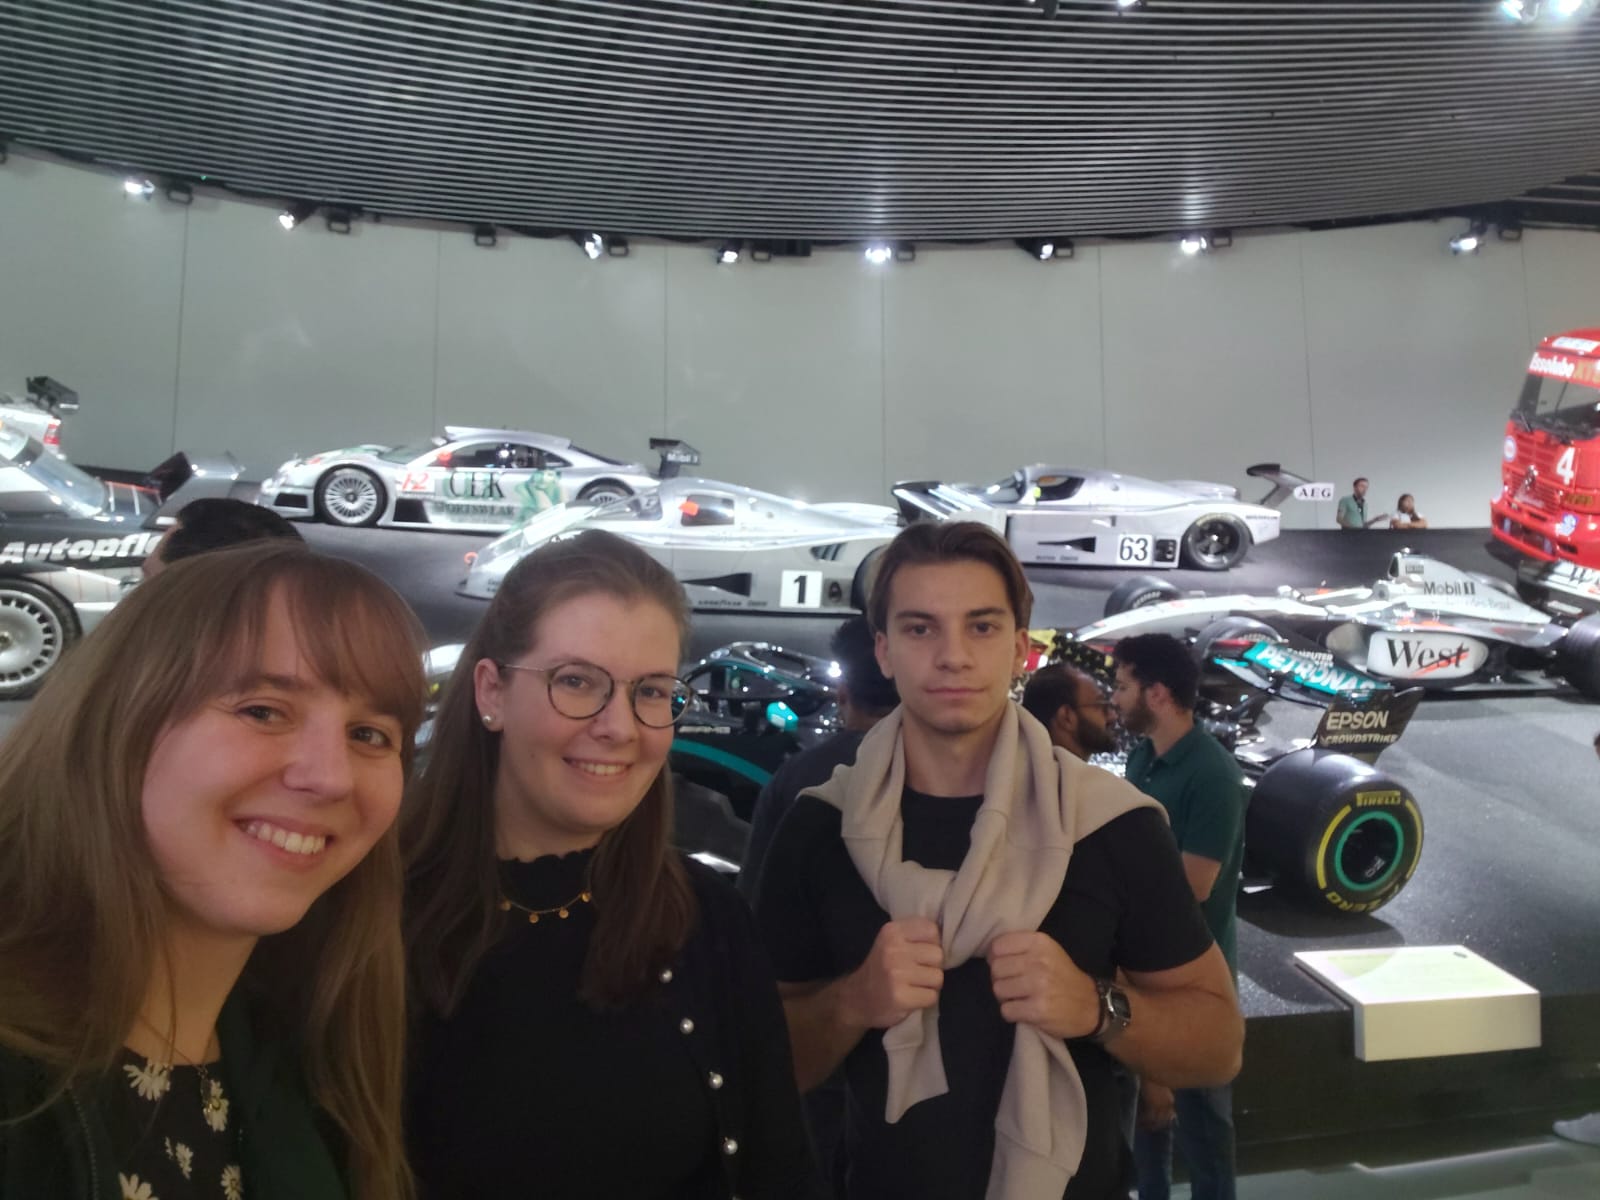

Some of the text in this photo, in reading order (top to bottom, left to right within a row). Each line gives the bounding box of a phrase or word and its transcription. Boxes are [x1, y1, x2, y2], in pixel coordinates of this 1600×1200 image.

[1555, 446, 1576, 486] 4
[402, 471, 429, 491] 12
[1300, 487, 1331, 498] AEG
[1119, 537, 1149, 561] 63
[794, 575, 807, 604] 1
[1424, 582, 1461, 595] Mobil
[1386, 639, 1470, 669] West
[1256, 643, 1376, 691] PETRONAS
[1326, 711, 1390, 731] EPSON
[1356, 790, 1401, 807] PIRELLI
[1326, 891, 1382, 912] ZERO
